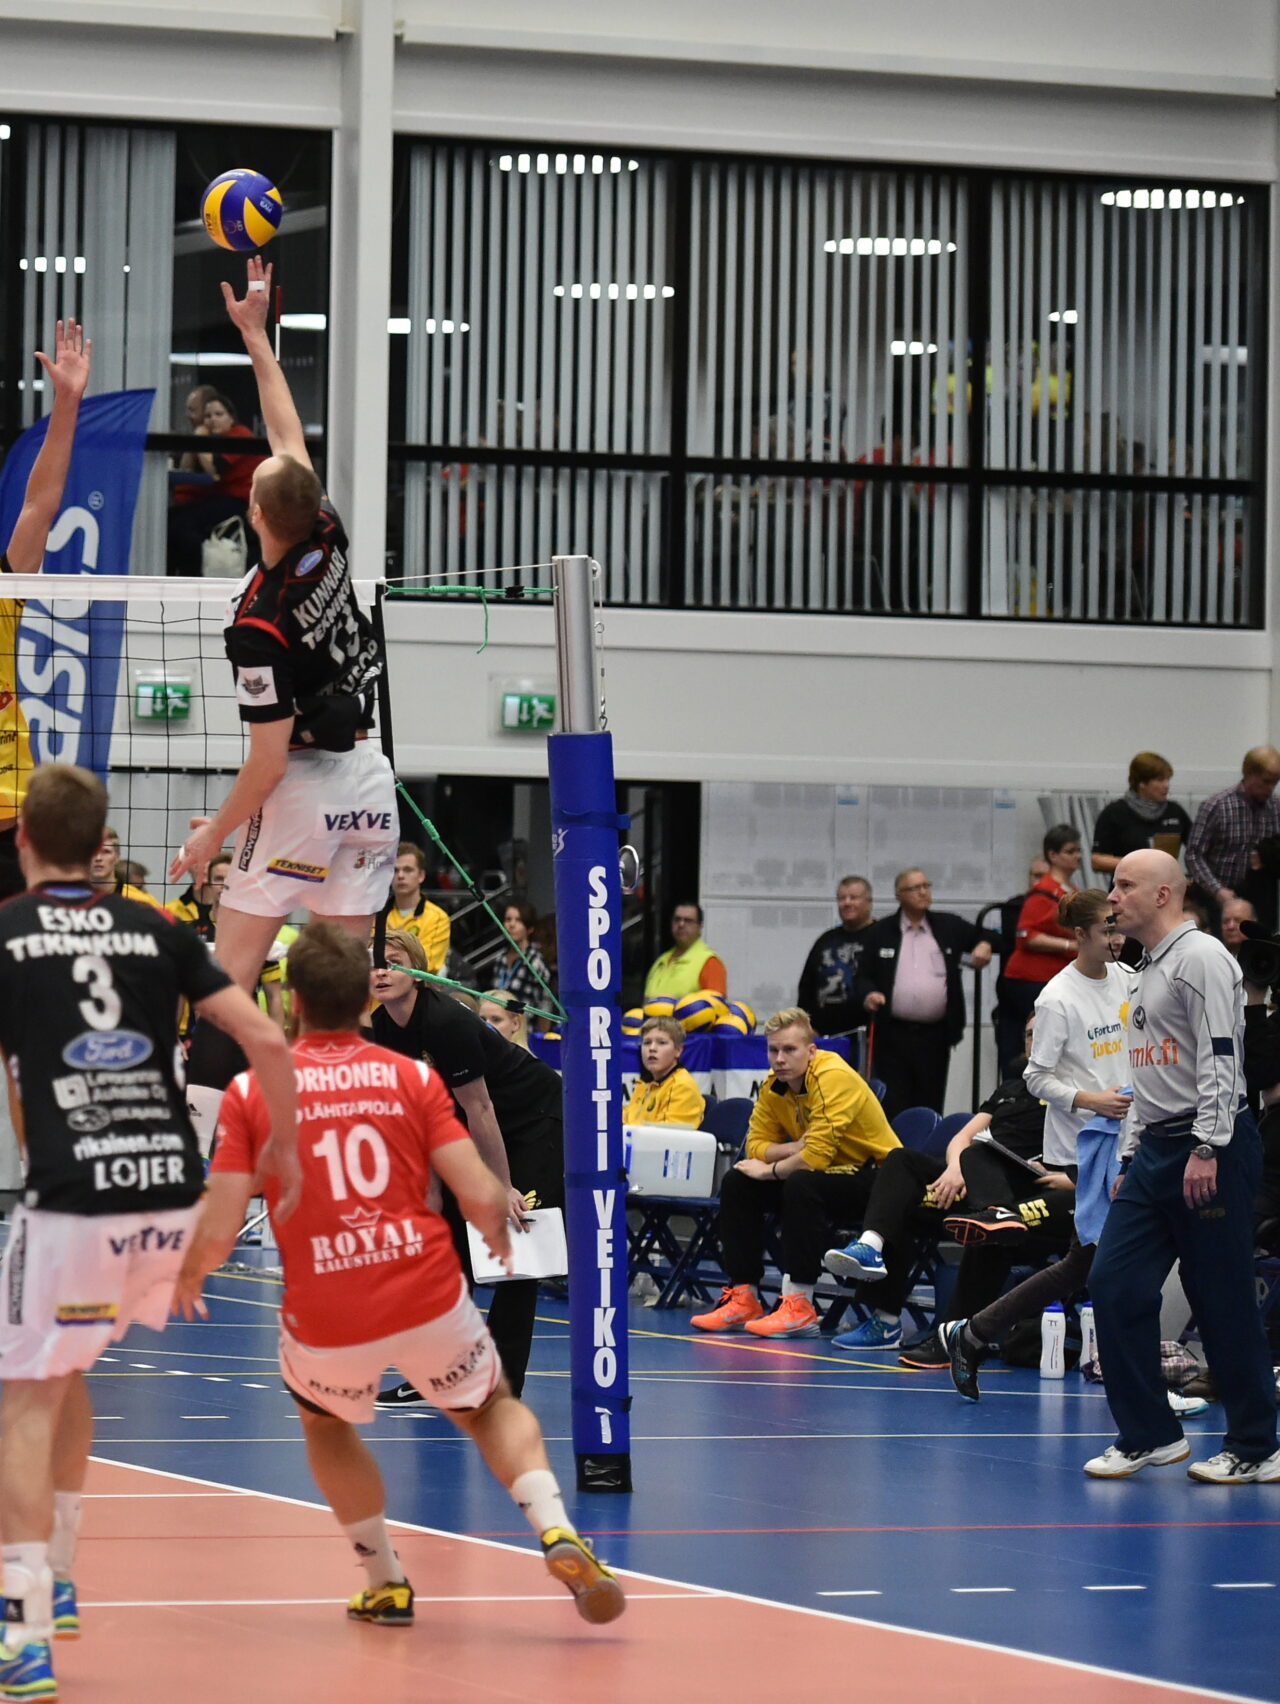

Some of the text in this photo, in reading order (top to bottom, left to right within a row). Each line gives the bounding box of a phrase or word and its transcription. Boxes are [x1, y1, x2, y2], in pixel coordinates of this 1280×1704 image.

[292, 545, 346, 629] KUNNARI
[324, 809, 392, 832] VEXVE
[275, 859, 325, 875] TEKNISET
[37, 905, 114, 932] ESKO
[5, 932, 160, 962] TEKNIKUM
[72, 954, 122, 1032] 3
[1094, 1023, 1122, 1038] Fortum
[94, 1155, 185, 1191] LOJER
[312, 1124, 389, 1201] 10
[310, 1219, 423, 1261] ROYAL
